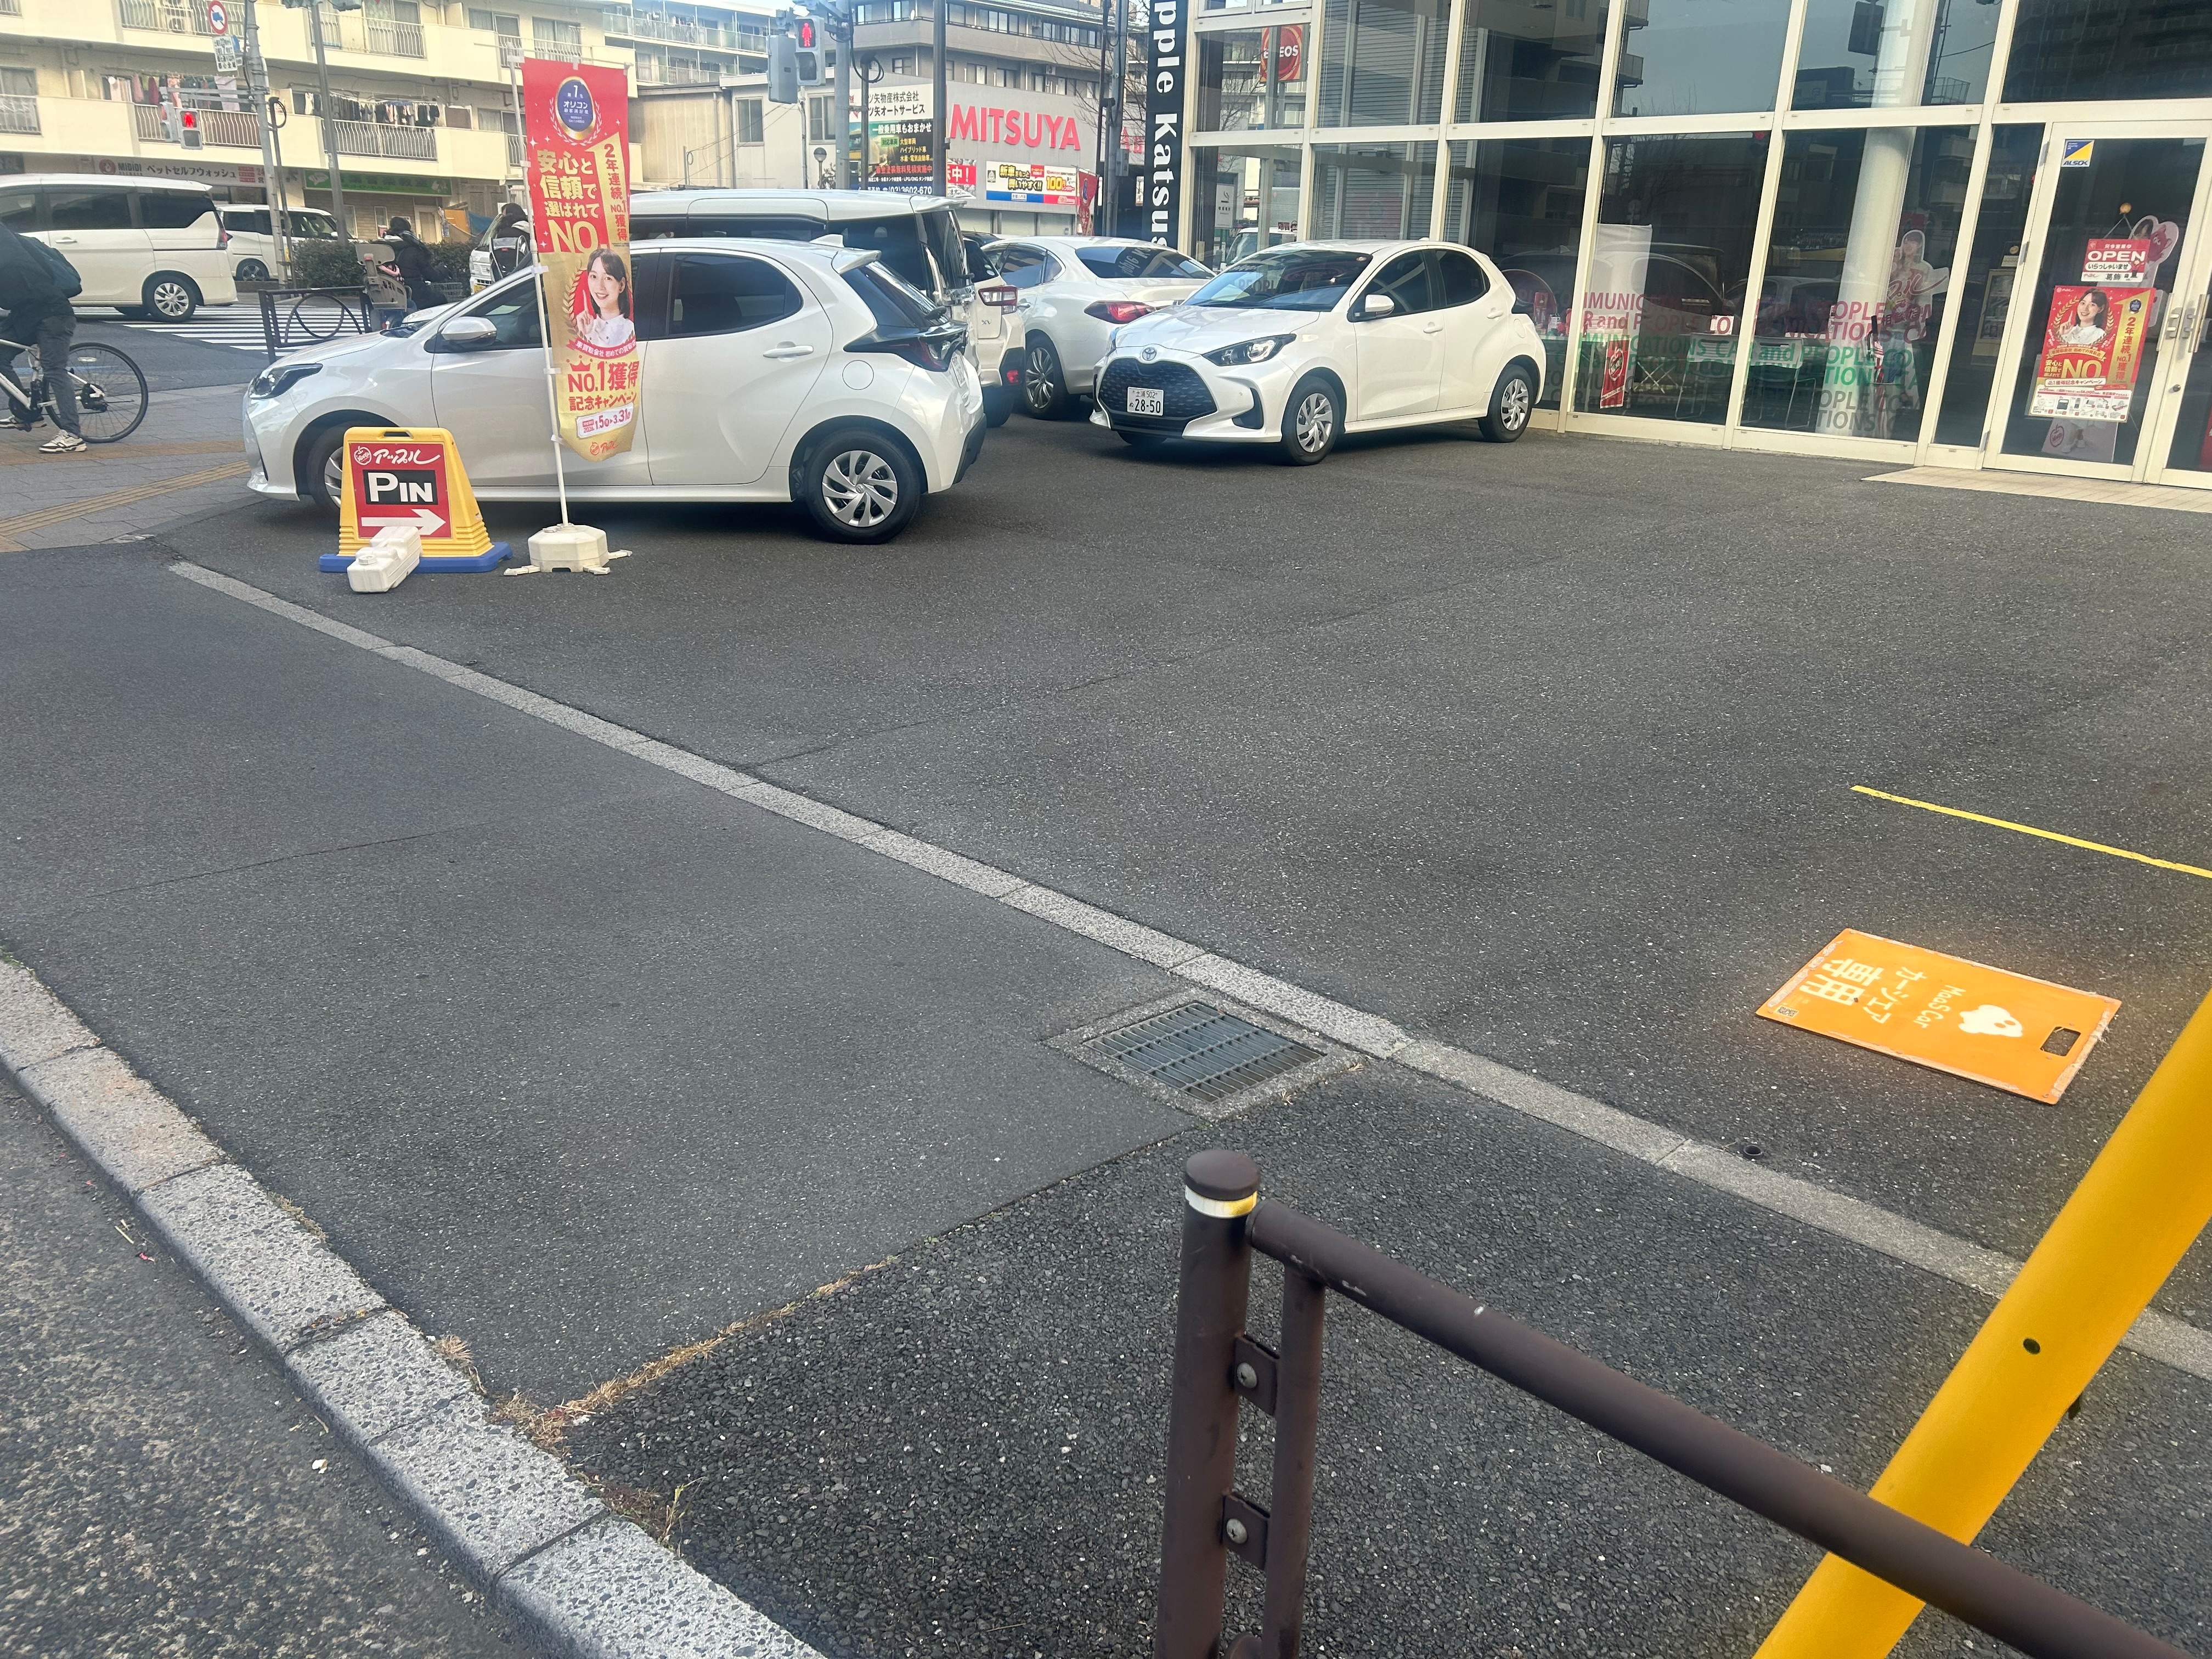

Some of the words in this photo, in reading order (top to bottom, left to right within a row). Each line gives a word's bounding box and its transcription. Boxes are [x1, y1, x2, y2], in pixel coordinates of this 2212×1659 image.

[868, 91, 919, 104] ツ矢物産株式会社
[868, 104, 925, 116] ツ矢オートサービス
[872, 122, 932, 134] 一般乗用車もおまかせ
[950, 104, 1081, 151] MITSUYA
[146, 165, 236, 178] ペットセルフウォッシュ
[537, 149, 594, 174] 安心と
[540, 174, 597, 200] 信頼で
[544, 201, 600, 218] 選ばれて
[2087, 250, 2146, 262] OPEN
[568, 391, 637, 411] 記念キャンペーン
[1135, 398, 1161, 413] 28-50
[1799, 958, 1884, 1006] 専用
[1864, 966, 1928, 1024] カーシェア
[1928, 984, 1967, 1012] MaaS
[1913, 1009, 1944, 1029] Car
